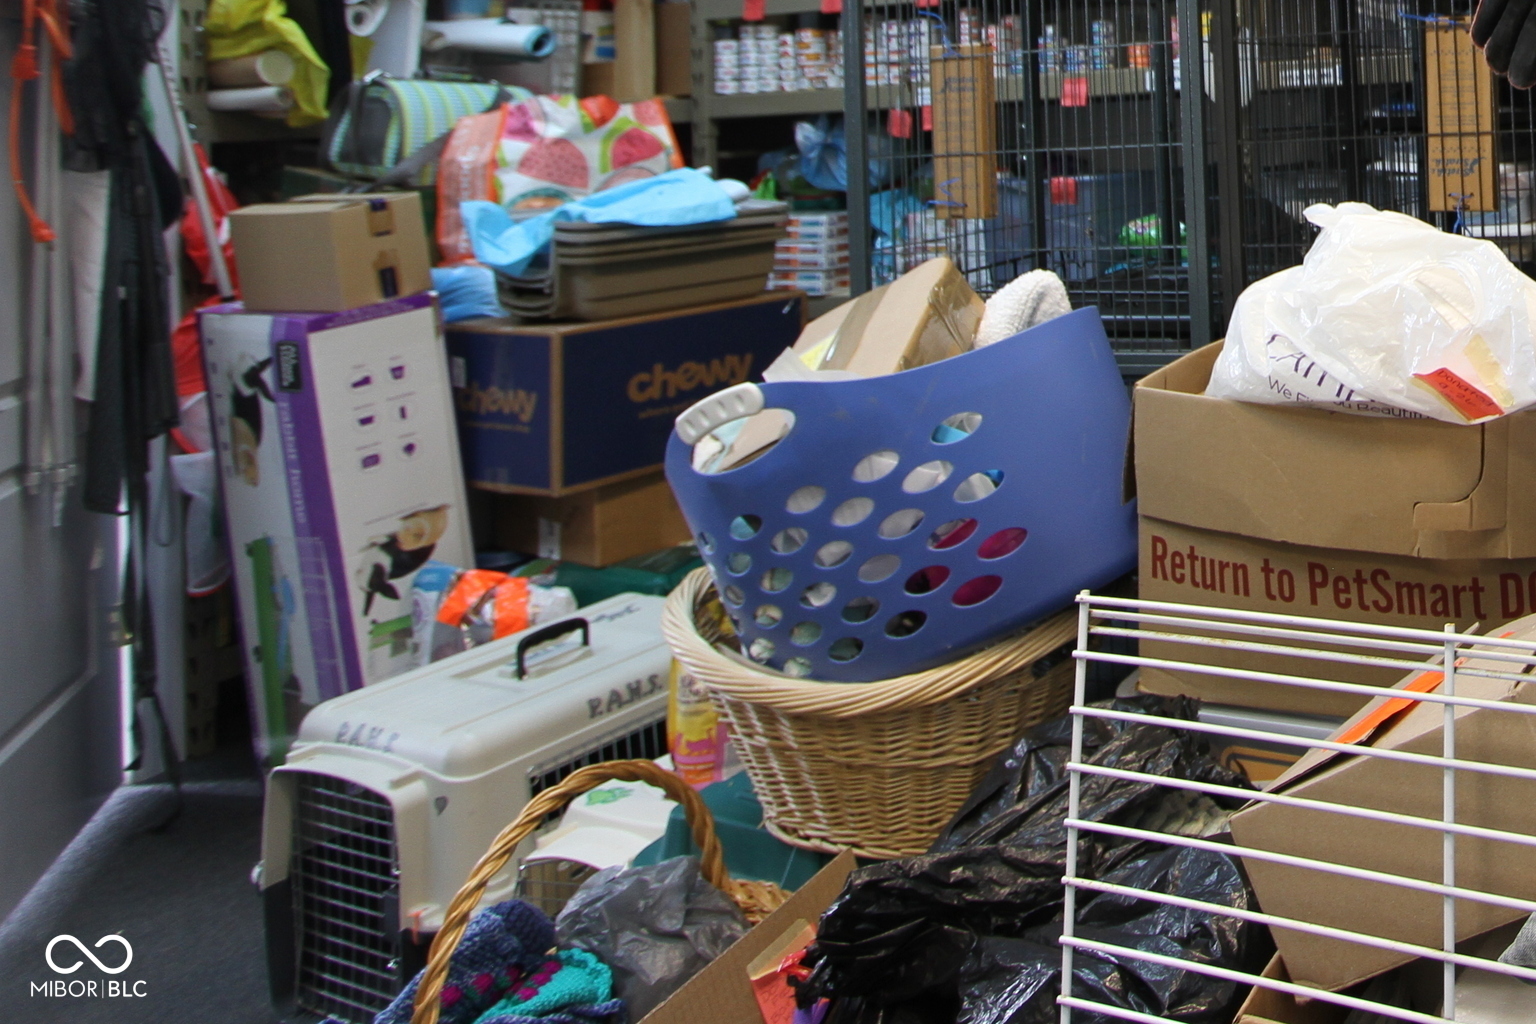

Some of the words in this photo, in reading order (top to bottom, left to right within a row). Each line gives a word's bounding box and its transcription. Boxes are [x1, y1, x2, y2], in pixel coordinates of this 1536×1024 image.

[627, 352, 754, 403] chewy
[1268, 375, 1292, 400] We
[1150, 535, 1251, 599] Return
[1261, 557, 1295, 604] to
[1307, 561, 1488, 622] PetSmart
